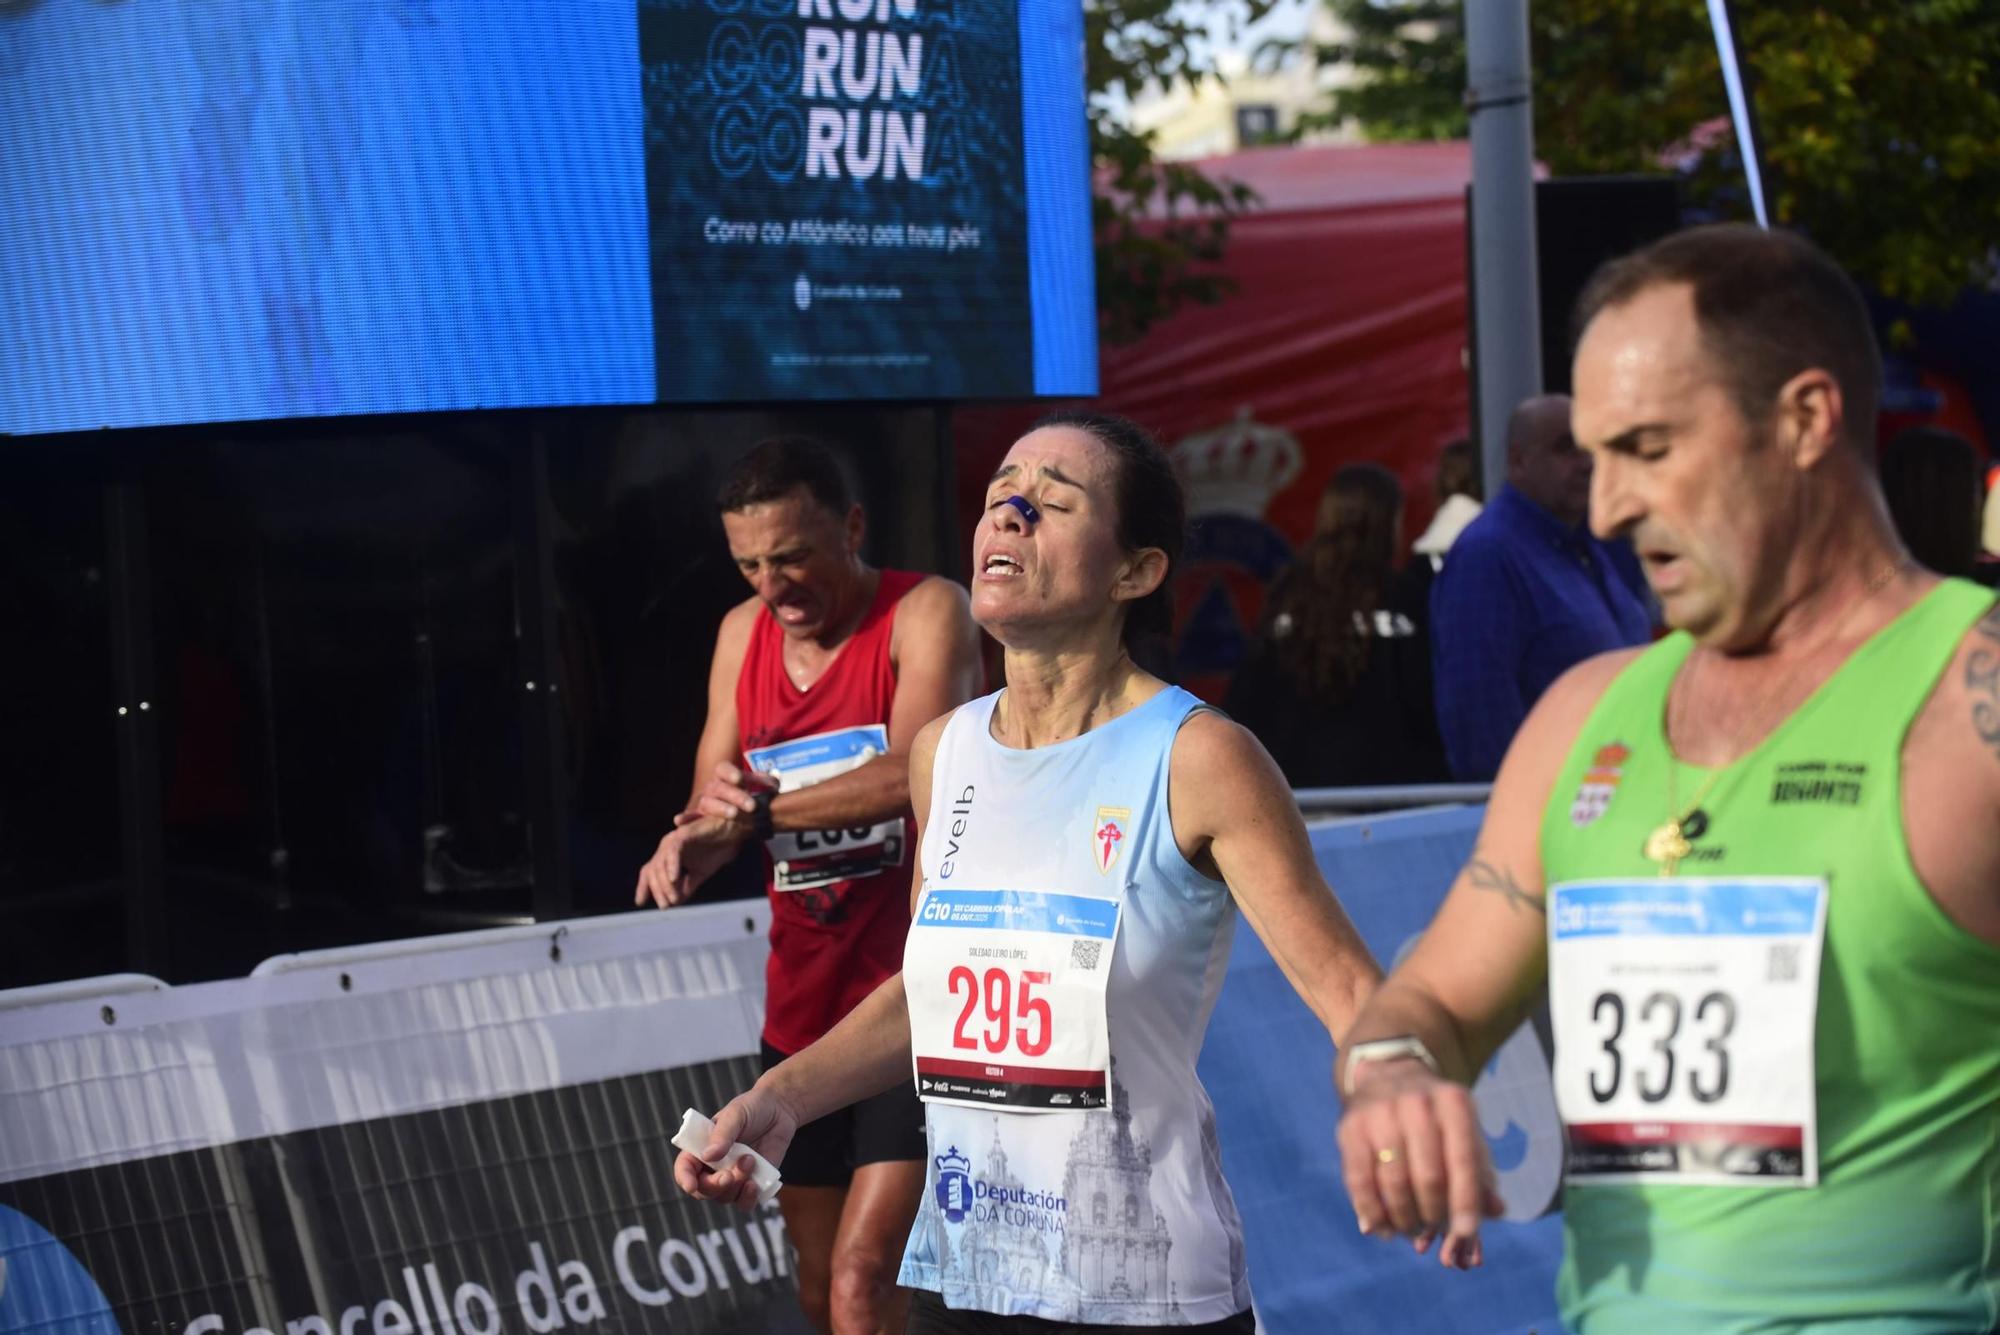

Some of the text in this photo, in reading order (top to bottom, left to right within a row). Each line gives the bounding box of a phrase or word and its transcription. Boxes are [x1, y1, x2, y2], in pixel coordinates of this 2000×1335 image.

[704, 217, 757, 244] Corre
[760, 221, 786, 245] co
[907, 222, 945, 247] teus
[939, 784, 975, 880] evelb
[969, 947, 992, 958] SOLEDAD
[992, 948, 1008, 959] LEIRO
[948, 965, 1052, 1057] 295
[1588, 991, 1737, 1105] 333
[975, 1180, 1067, 1211] Deputación
[975, 1203, 1065, 1236] DA CORUÑA
[182, 1262, 500, 1335] cello
[515, 1241, 607, 1334] da
